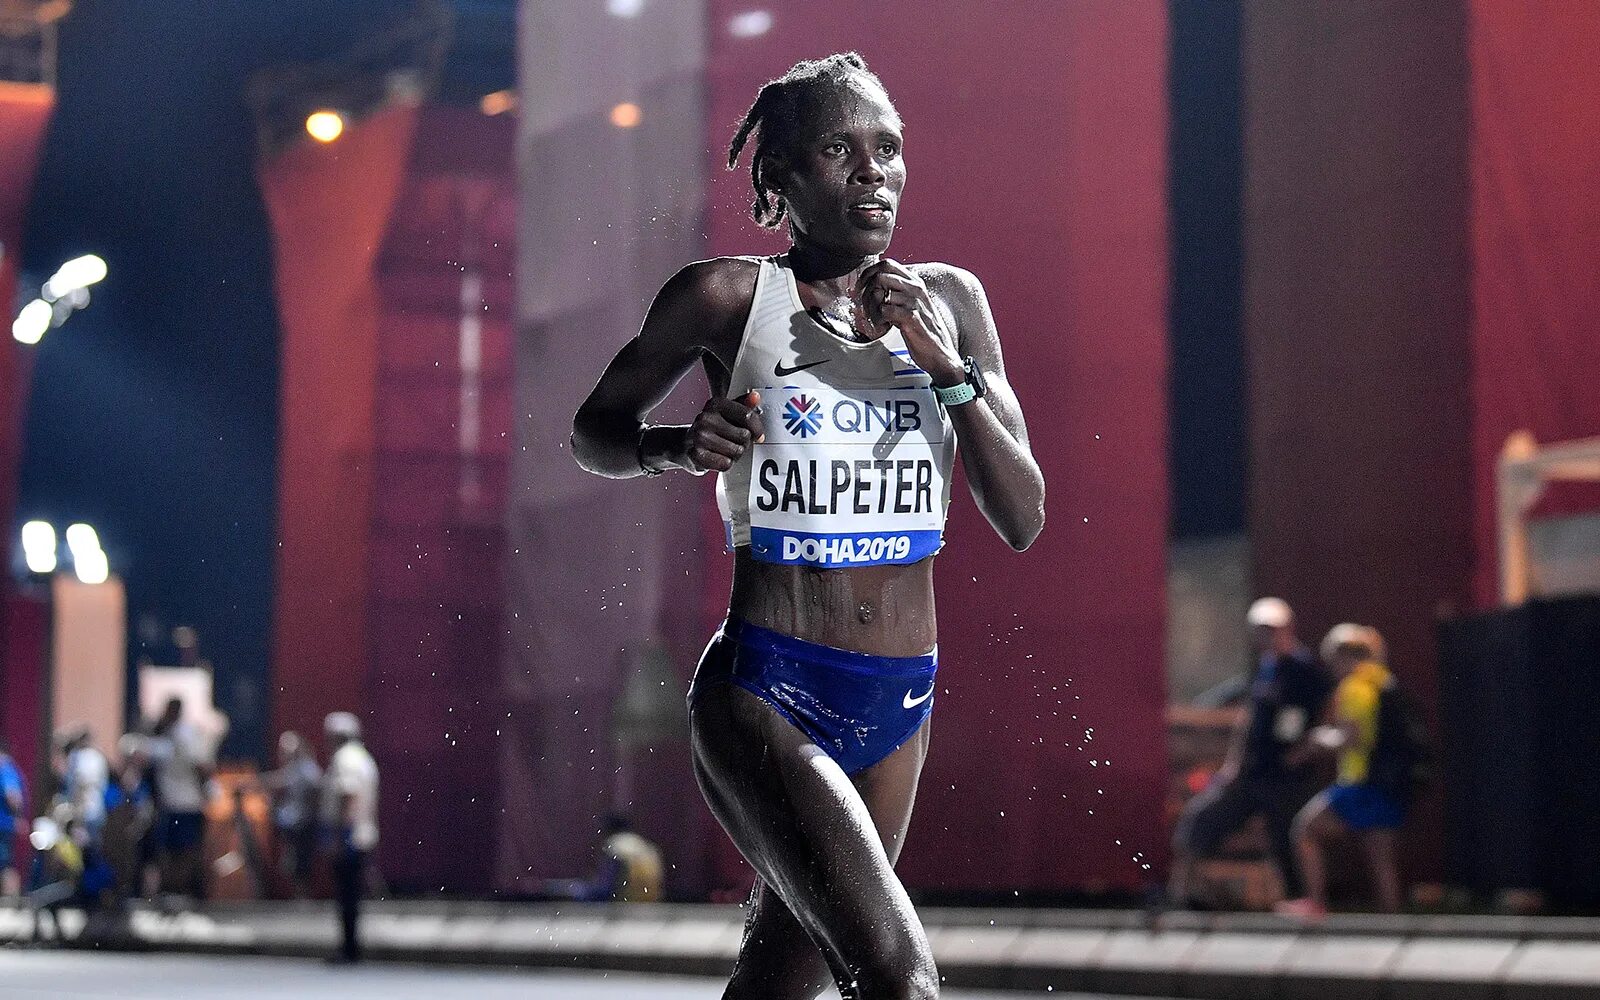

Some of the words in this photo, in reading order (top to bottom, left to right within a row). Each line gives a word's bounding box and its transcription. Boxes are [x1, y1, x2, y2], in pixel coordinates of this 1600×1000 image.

[832, 400, 921, 433] QNB
[757, 459, 932, 514] SALPETER
[783, 536, 910, 563] DOHA2019
